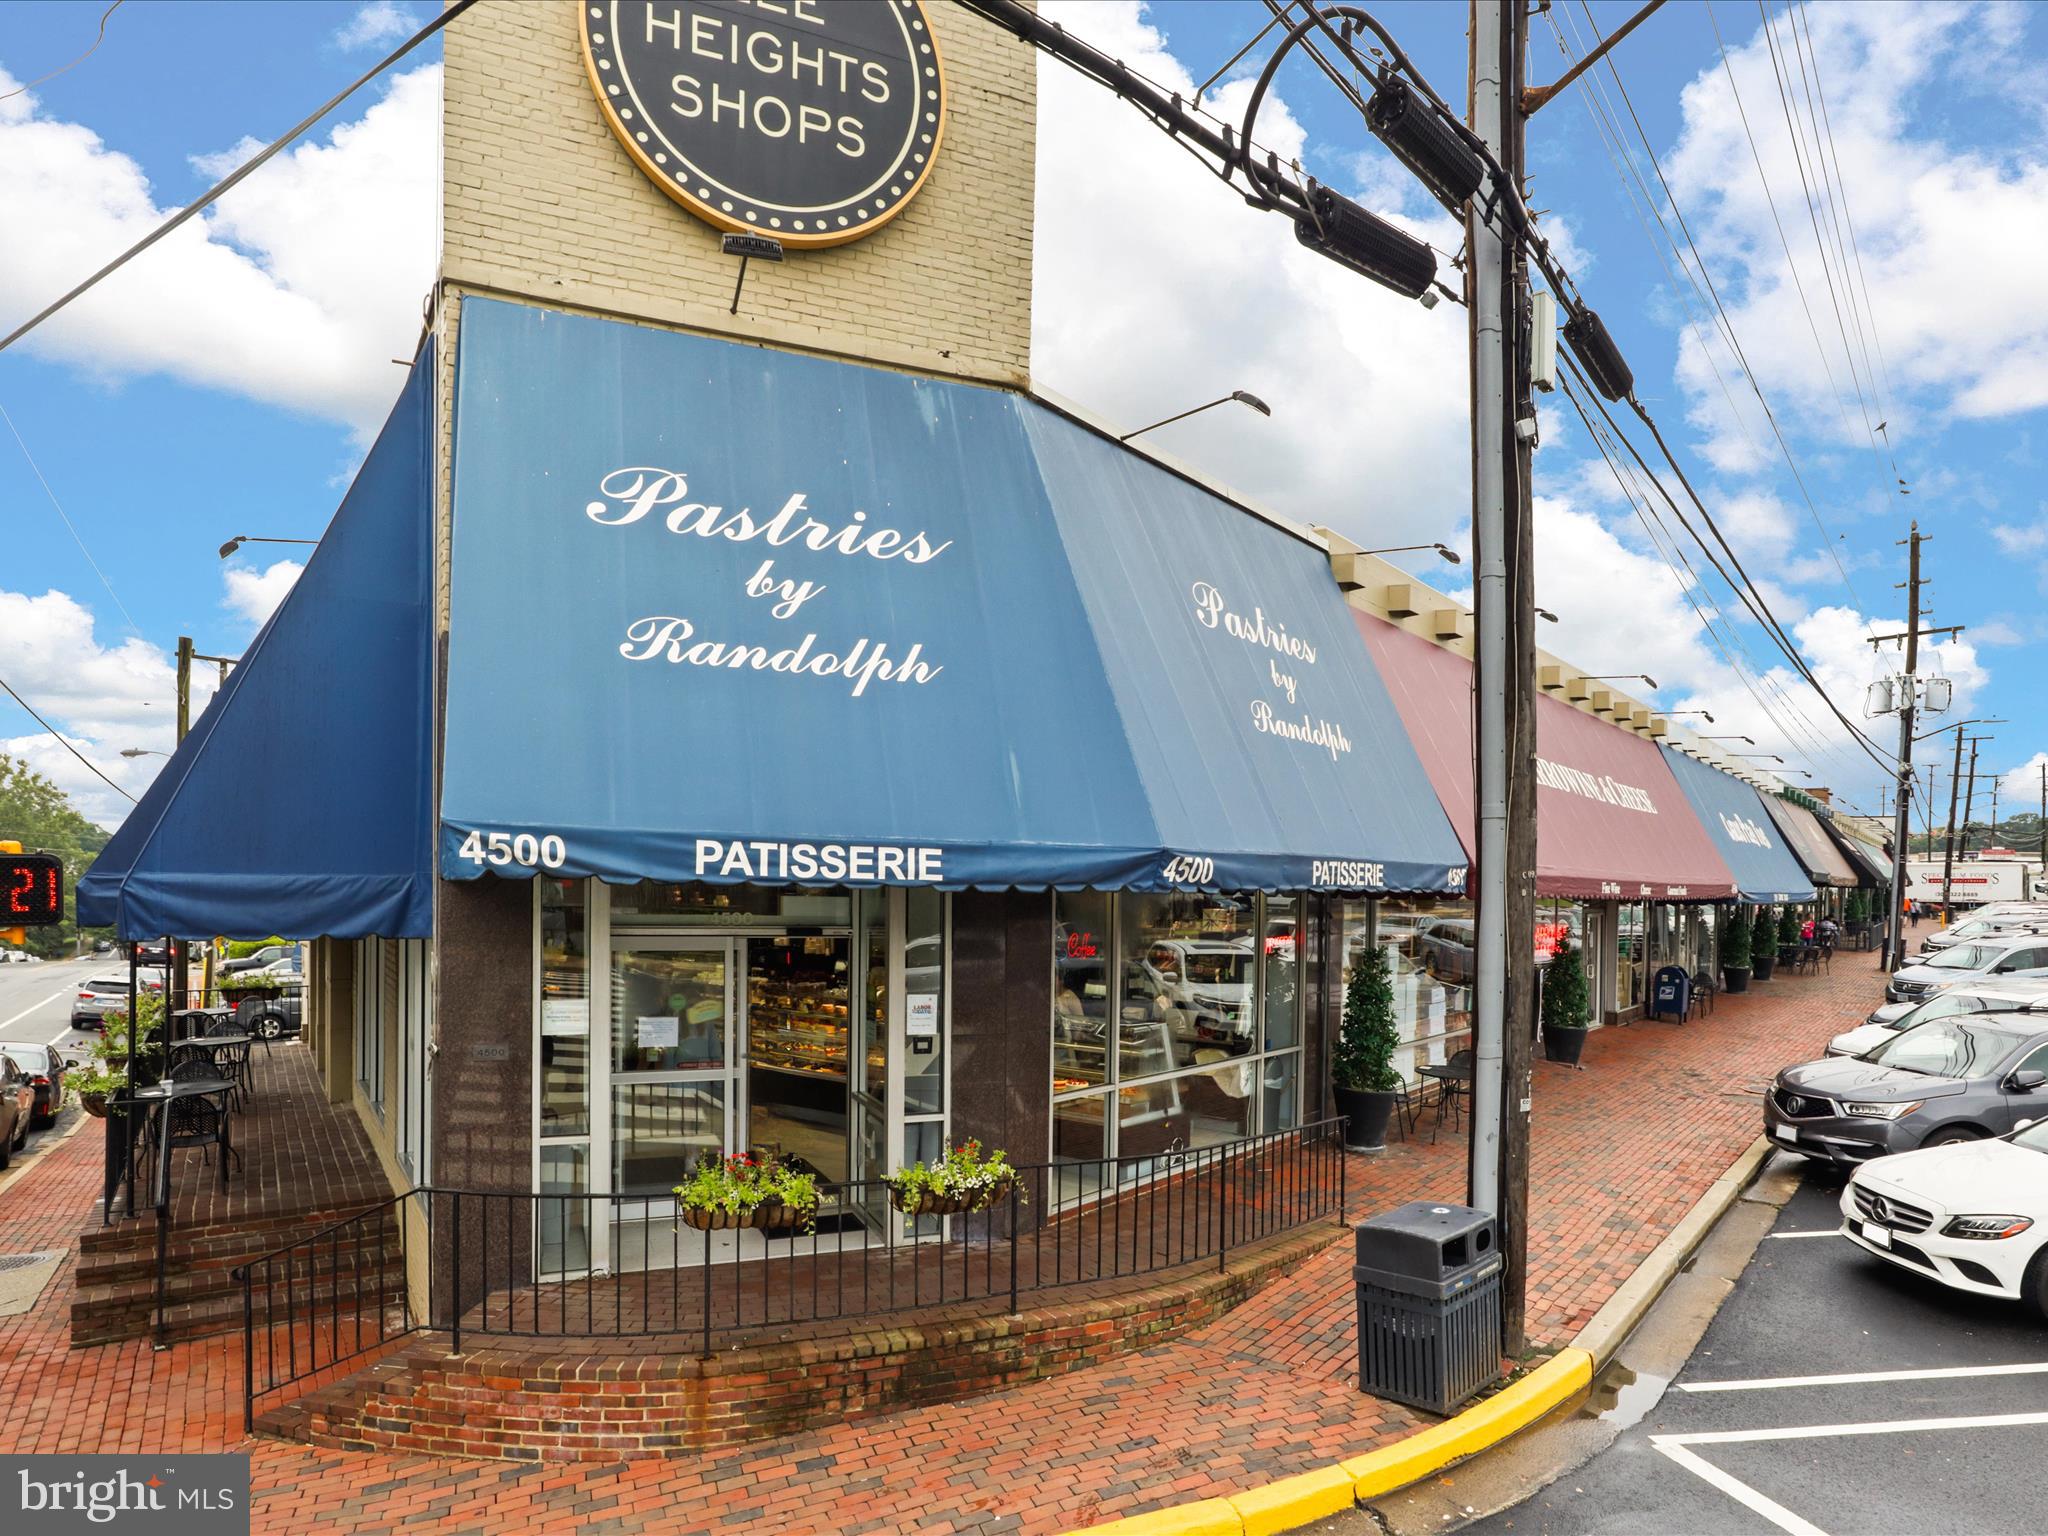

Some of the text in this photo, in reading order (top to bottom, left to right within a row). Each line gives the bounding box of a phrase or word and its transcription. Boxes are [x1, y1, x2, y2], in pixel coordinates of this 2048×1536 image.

[645, 2, 891, 104] HEIGHTS
[670, 74, 866, 158] SHOPS
[586, 466, 953, 564] Pastries
[745, 559, 827, 620] by
[1192, 581, 1316, 664] Pastries
[619, 615, 944, 697] Randolph
[1270, 659, 1297, 704] by
[1250, 699, 1352, 761] Randolph
[458, 830, 945, 881] 4500 PATISSERIE
[1162, 856, 1214, 884] 4500
[1312, 860, 1385, 887] PATISSERIE
[11, 867, 57, 912] 21
[1067, 932, 1097, 960] Coffee
[478, 1048, 505, 1057] 4500
